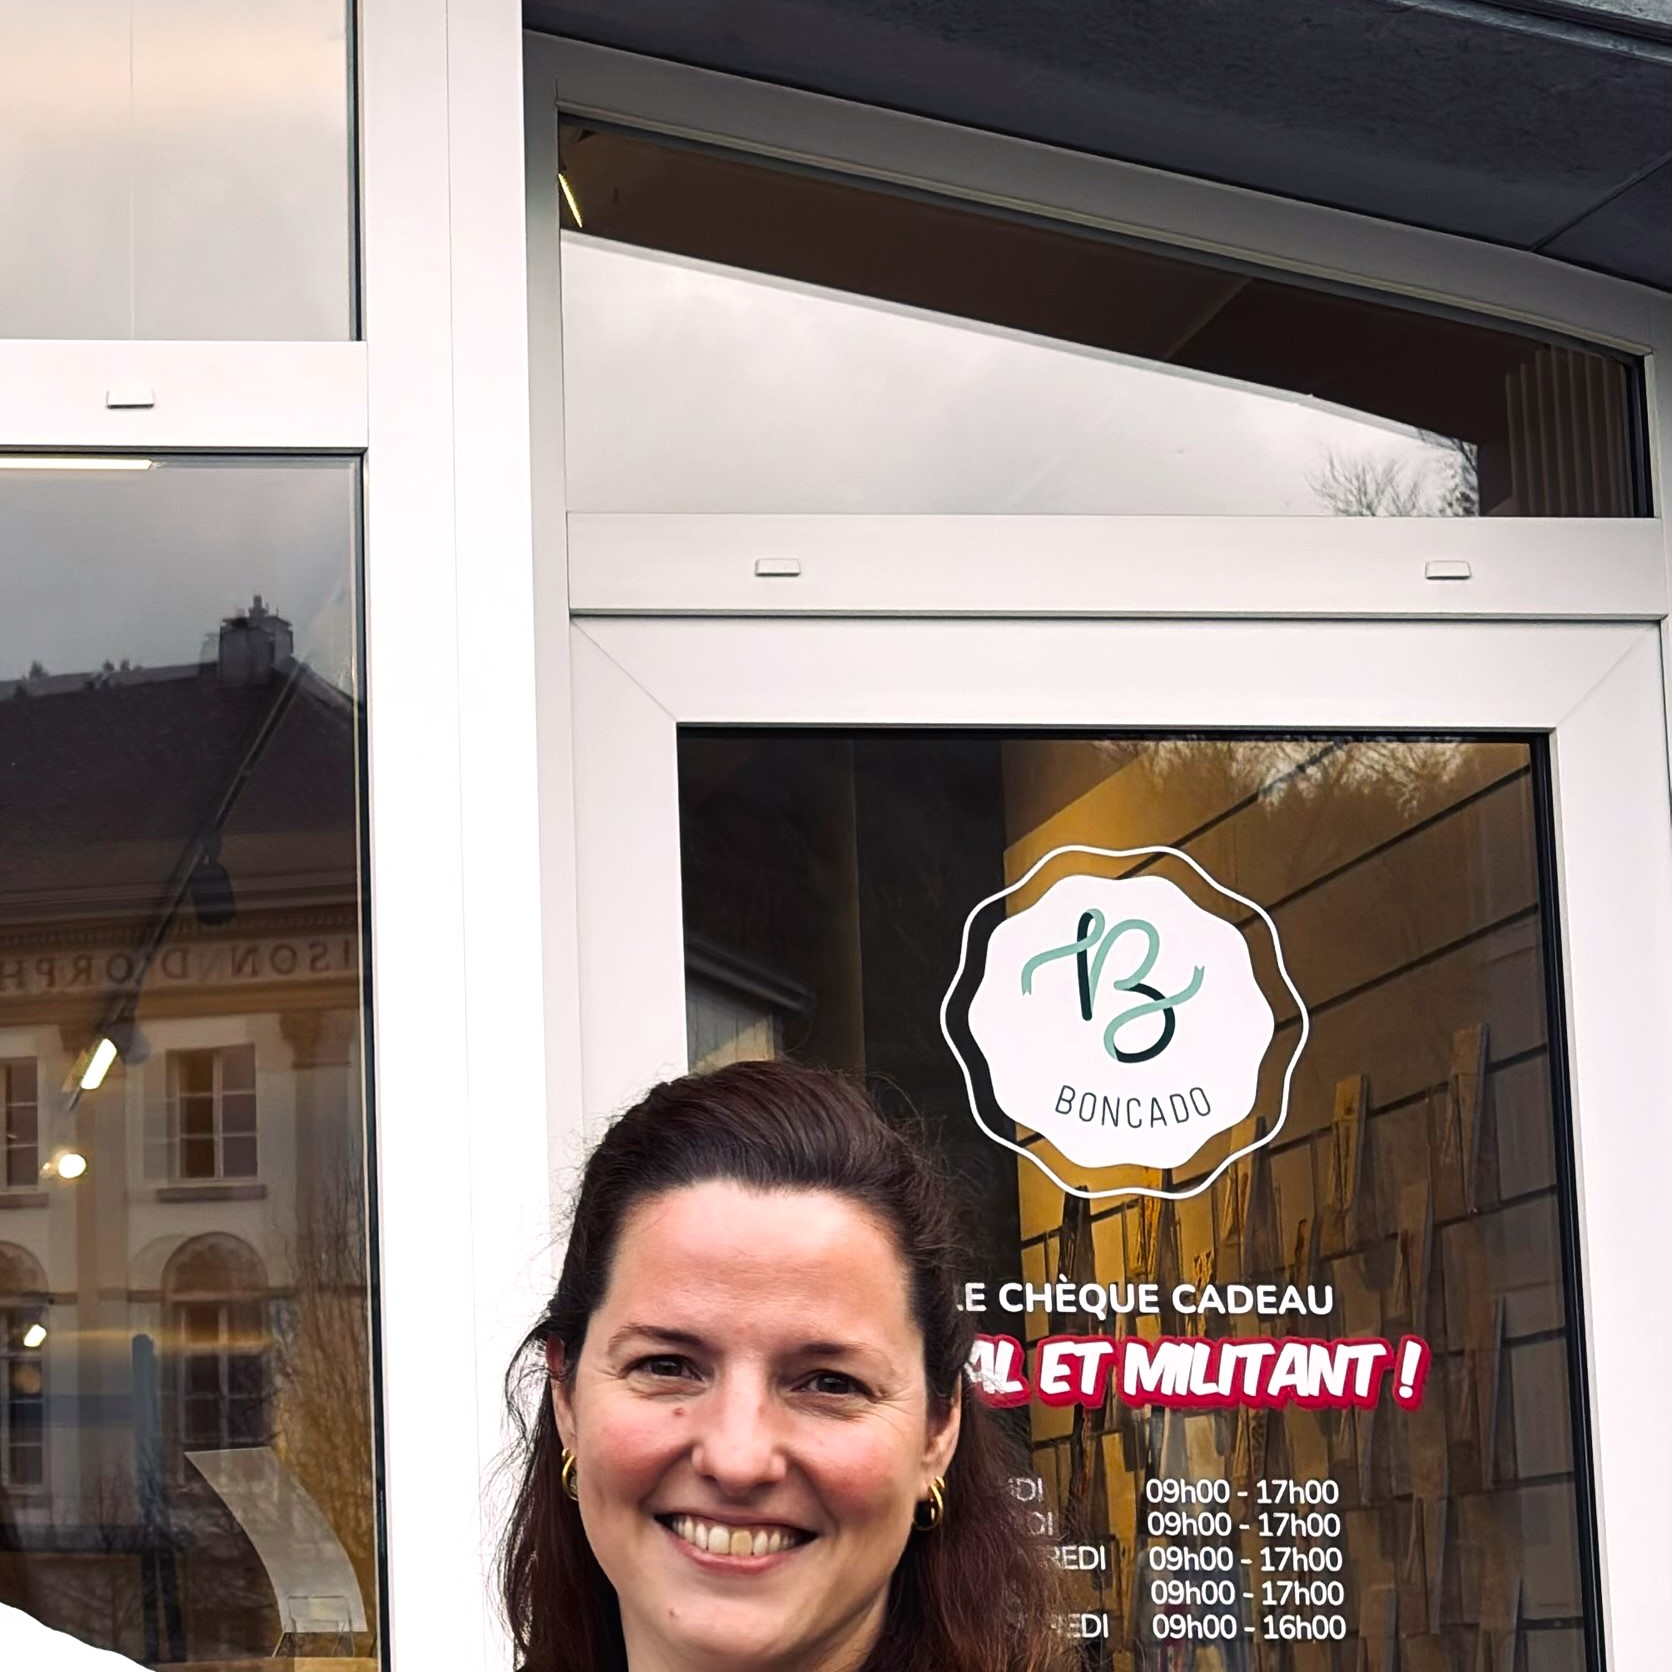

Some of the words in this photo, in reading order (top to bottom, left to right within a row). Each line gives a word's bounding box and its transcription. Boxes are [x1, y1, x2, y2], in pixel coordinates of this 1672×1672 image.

[1055, 1085, 1211, 1129] BONCADO
[956, 1282, 986, 1313] E
[998, 1274, 1160, 1321] CHÈQUE
[1171, 1284, 1334, 1315] CADEAU
[1038, 1339, 1114, 1396] ET
[1121, 1340, 1388, 1399] MILITANT
[1145, 1478, 1230, 1505] 09h00
[1254, 1479, 1339, 1506] 17h00
[1147, 1511, 1232, 1538] 09h00
[1256, 1512, 1341, 1539] 17h00
[1149, 1545, 1234, 1572] 09h00
[1258, 1546, 1343, 1573] 17h00
[1150, 1579, 1235, 1606] 09h00
[1259, 1580, 1344, 1607] 17h00
[1152, 1614, 1237, 1641] 09h00
[1261, 1615, 1346, 1642] 16h00
